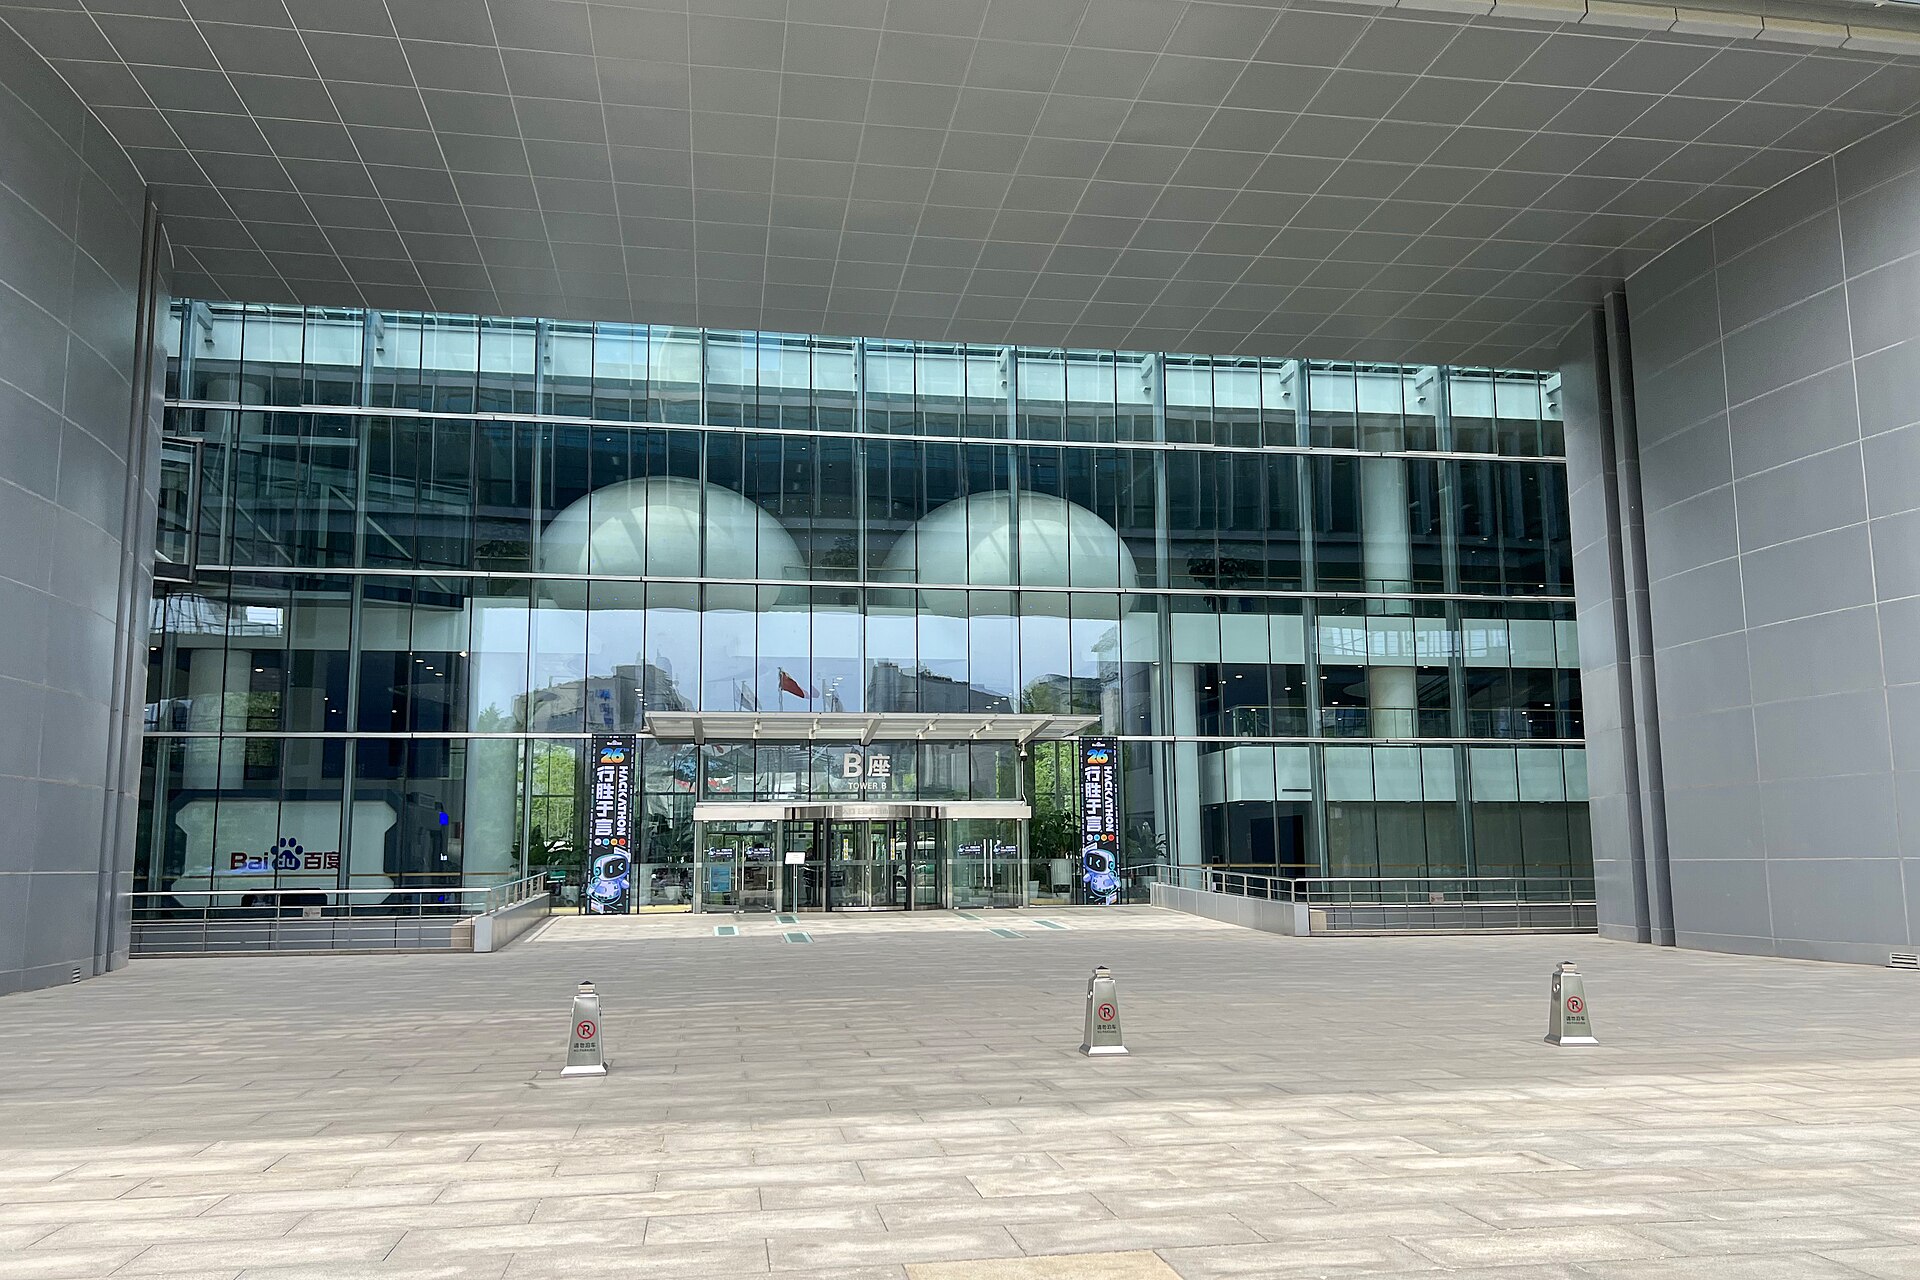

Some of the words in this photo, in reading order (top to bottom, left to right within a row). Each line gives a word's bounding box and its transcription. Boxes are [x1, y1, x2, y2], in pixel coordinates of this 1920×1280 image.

[842, 753, 891, 777] B座
[848, 782, 878, 790] TOWER
[881, 781, 887, 790] B
[1084, 765, 1102, 832] 行胜于言
[1103, 765, 1114, 832] HACKATHON
[595, 765, 615, 836] 行胜于言
[617, 765, 628, 836] HACKATHON
